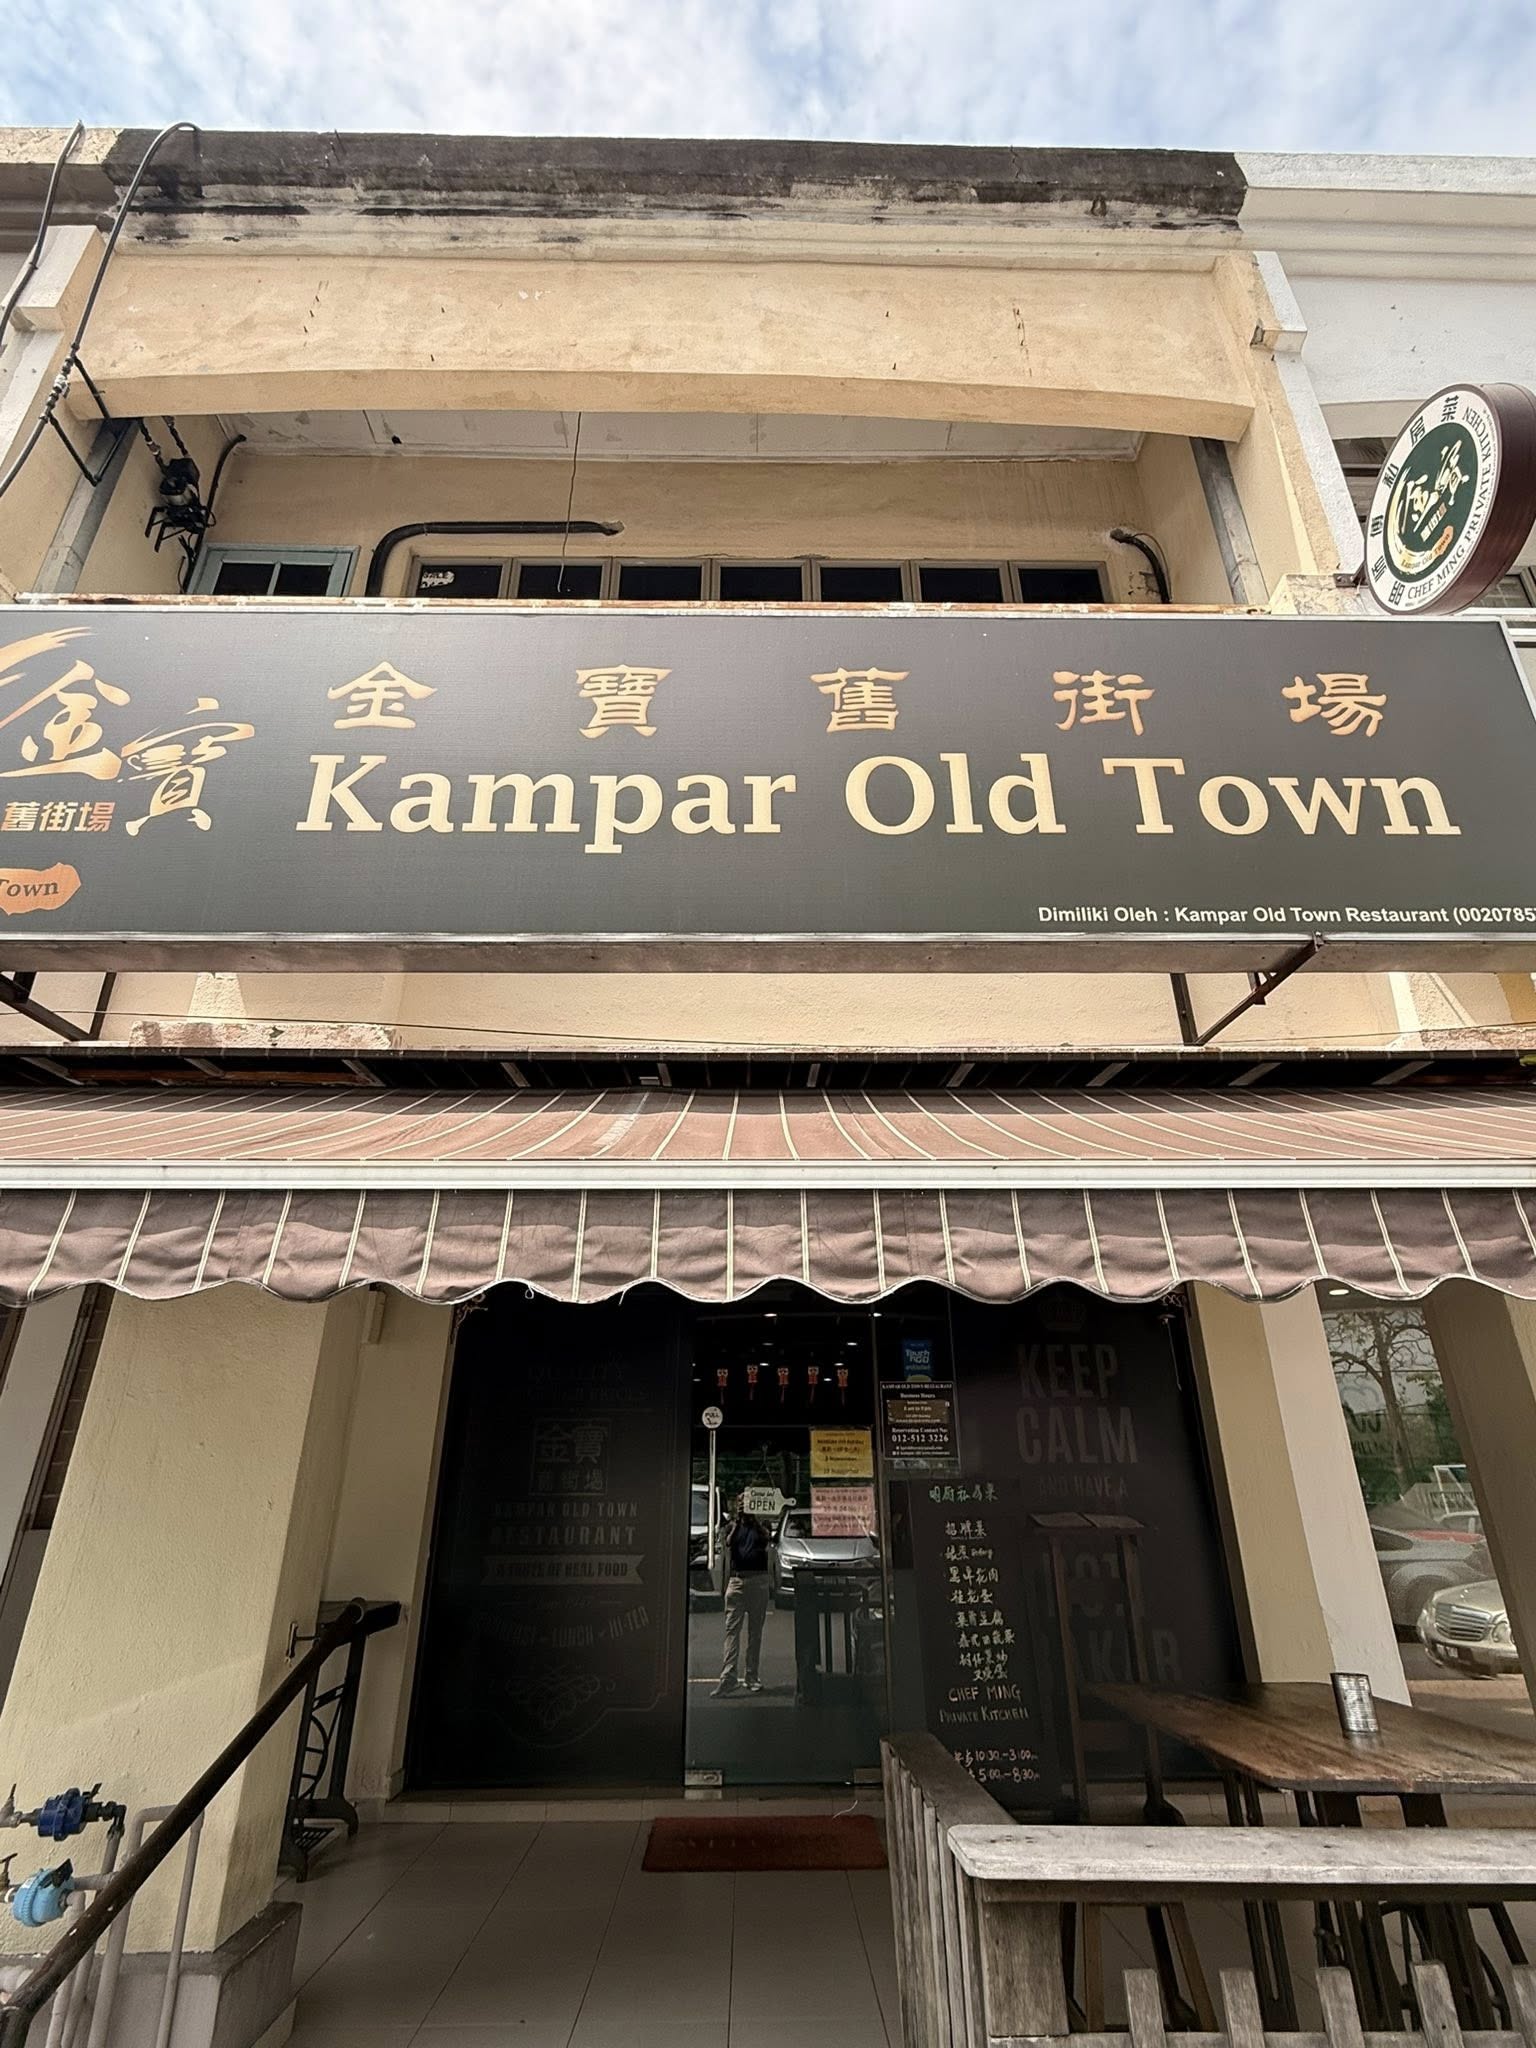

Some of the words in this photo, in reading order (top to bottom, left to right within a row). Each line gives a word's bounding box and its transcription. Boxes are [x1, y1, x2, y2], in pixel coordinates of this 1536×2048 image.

[1464, 406, 1491, 463] KITCHEN
[1464, 467, 1491, 543] PRIVATE
[1437, 546, 1466, 581] MING
[1407, 578, 1434, 600] CHEF
[327, 660, 1387, 738] 金寶舊街場
[1, 801, 116, 833] 舊街場
[296, 754, 796, 855] Kampar
[845, 753, 1067, 836] Old
[1102, 757, 1461, 836] Town
[1038, 906, 1108, 922] Dimiliki
[1113, 906, 1158, 922] Oleh
[1174, 906, 1248, 925] Kampar
[1253, 906, 1287, 922] Old
[1290, 907, 1341, 922] Town
[1345, 907, 1449, 922] Restaurant
[1016, 1343, 1121, 1399] KEEP
[891, 1434, 926, 1443] 012-512
[928, 1434, 949, 1443] 3226
[1016, 1406, 1138, 1463] CALM
[1073, 1472, 1112, 1497] HAVE
[562, 1502, 591, 1518] OLD
[597, 1502, 638, 1518] TOWN
[749, 1501, 776, 1511] OPEN
[597, 1562, 628, 1577] FOOD
[948, 1686, 979, 1703] CHEF
[986, 1683, 1022, 1703] MING
